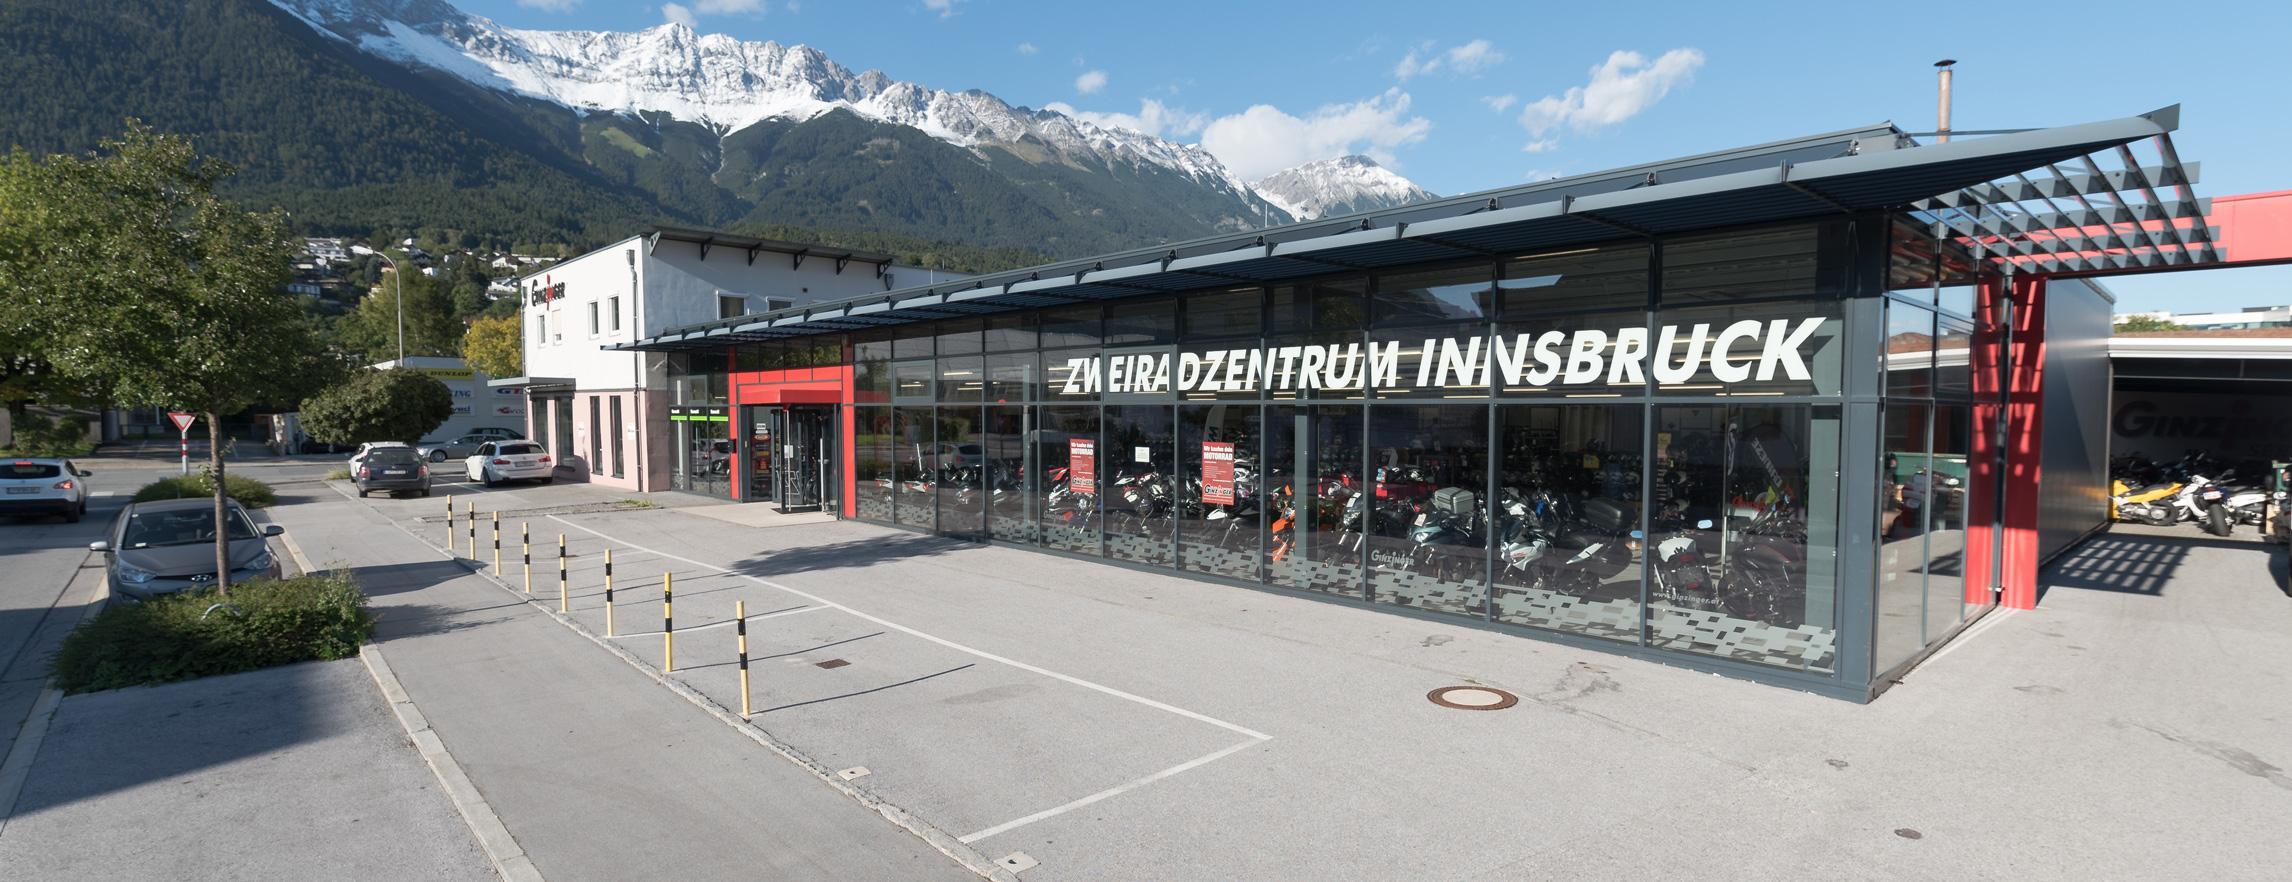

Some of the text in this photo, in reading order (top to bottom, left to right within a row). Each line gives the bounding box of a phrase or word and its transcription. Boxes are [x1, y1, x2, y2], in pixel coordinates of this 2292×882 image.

[1063, 317, 1827, 393] ZWEIRADZENTRUM INNSBRUCK
[1203, 452, 1233, 461] MOTORRAD
